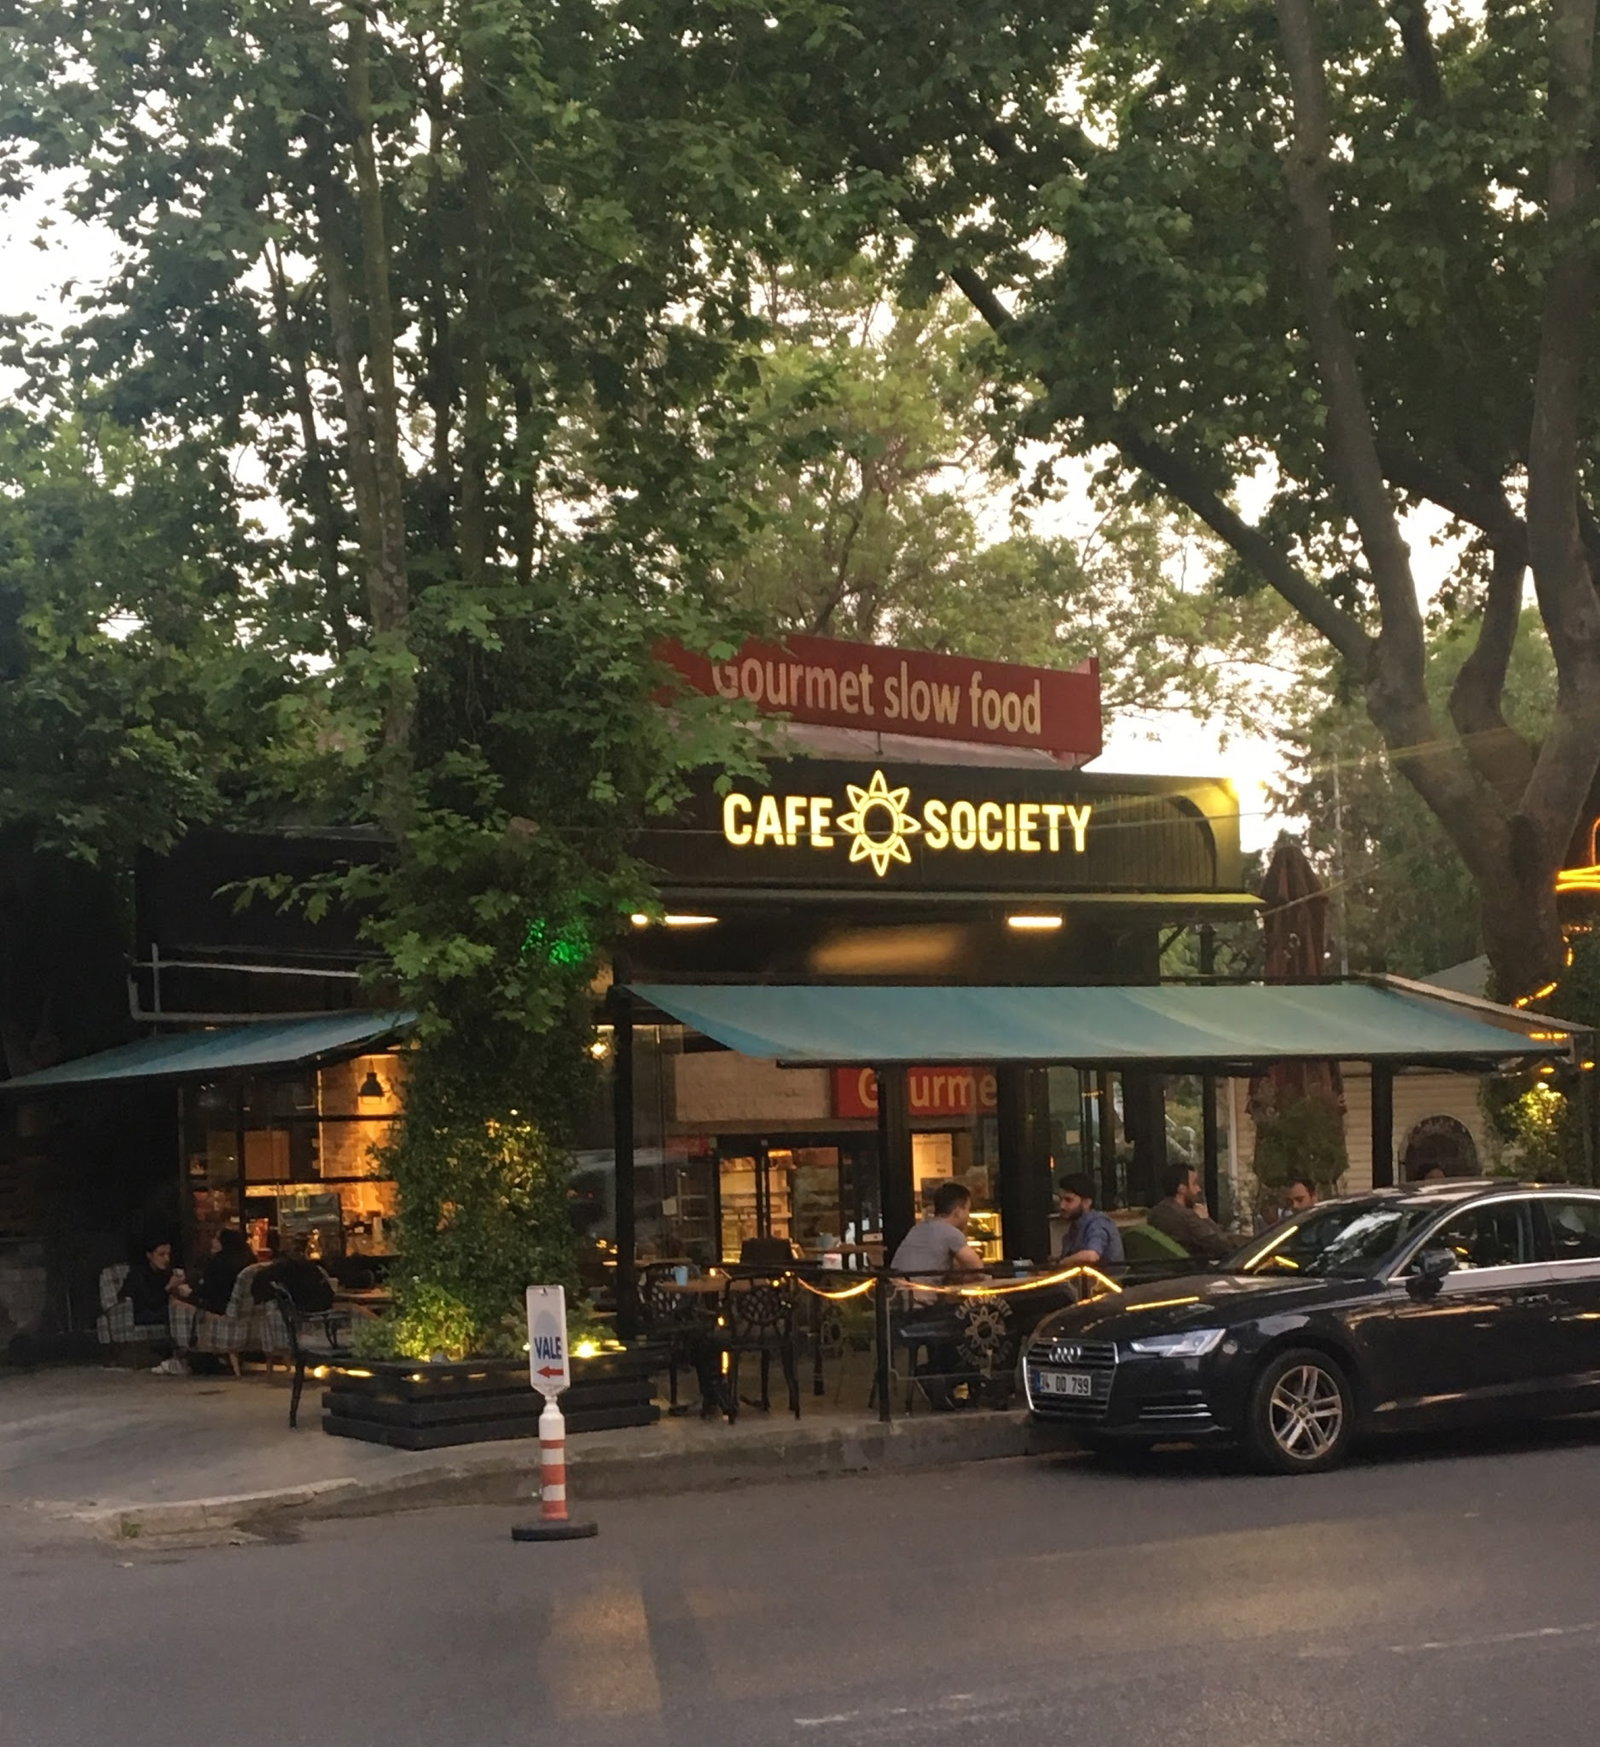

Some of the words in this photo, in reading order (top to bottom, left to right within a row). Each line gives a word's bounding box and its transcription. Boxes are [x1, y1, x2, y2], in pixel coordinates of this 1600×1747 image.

[711, 657, 874, 716] Gourmet
[883, 660, 961, 725] slow
[968, 670, 1042, 735] food
[723, 794, 834, 847] CAFE
[923, 800, 1092, 852] SOCIETY
[534, 1336, 563, 1360] VALE
